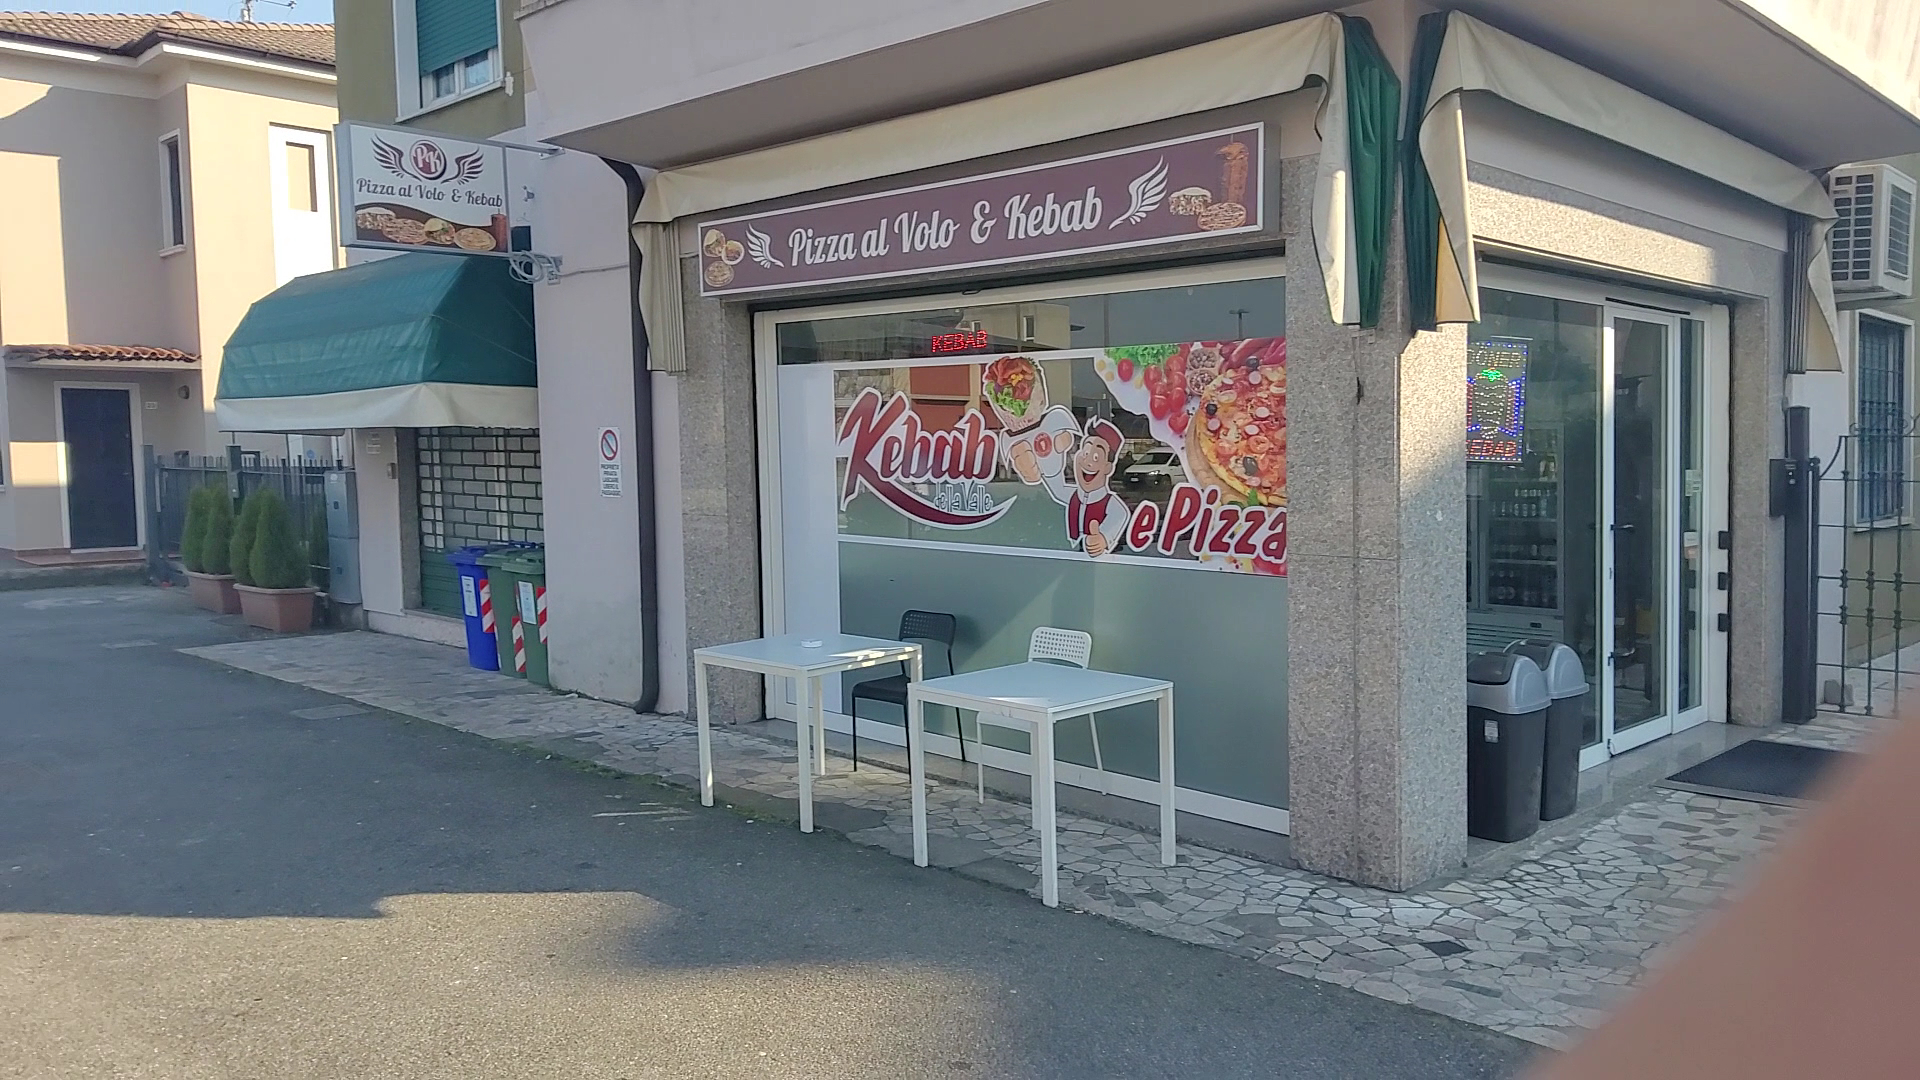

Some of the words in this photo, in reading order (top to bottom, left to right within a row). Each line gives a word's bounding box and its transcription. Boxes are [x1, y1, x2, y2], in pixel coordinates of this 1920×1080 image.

[412, 144, 441, 173] PK
[356, 178, 395, 196] Pizza
[396, 184, 412, 198] al
[415, 185, 446, 201] Volo
[451, 189, 461, 202] &
[465, 190, 503, 208] Kebab
[788, 228, 857, 267] Pizza
[861, 218, 888, 258] al
[893, 210, 960, 253] Volo
[970, 200, 997, 244] &
[1003, 186, 1103, 240] Kebab
[931, 330, 988, 352] KEBAB
[839, 388, 1010, 520] Kebab
[1466, 439, 1516, 456] EBAB
[1128, 503, 1157, 550] e
[1160, 485, 1287, 561] Pizza
